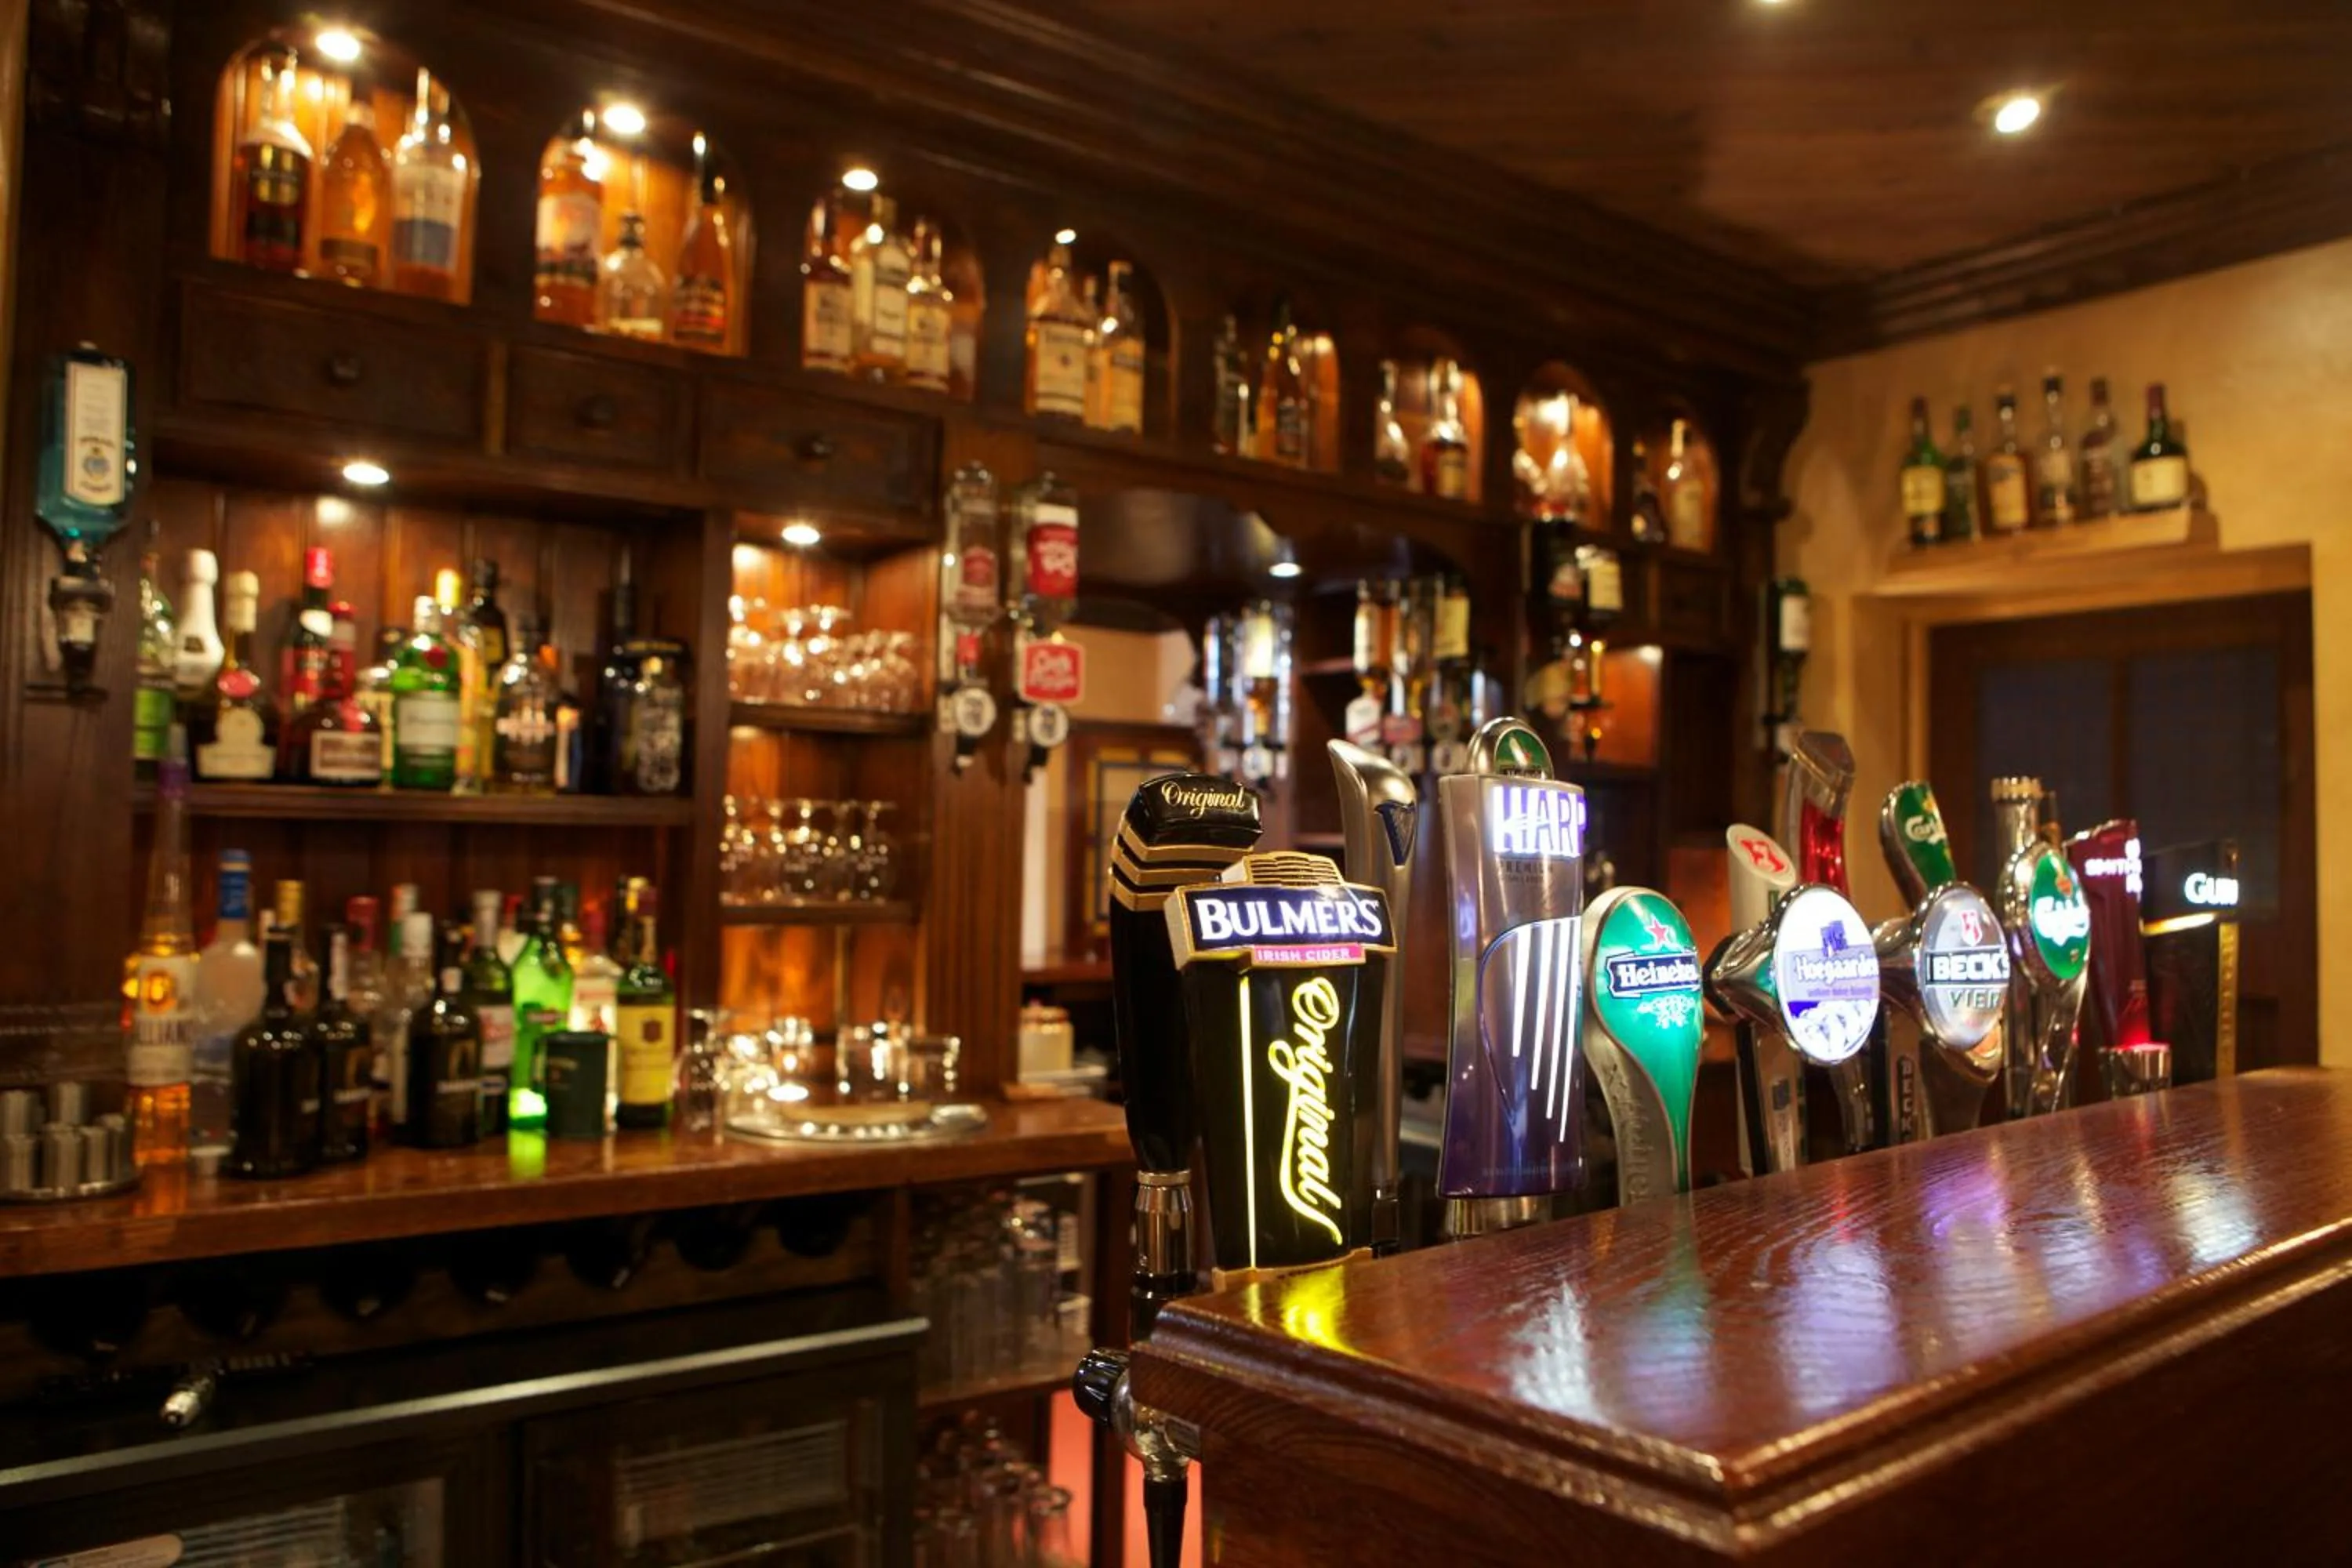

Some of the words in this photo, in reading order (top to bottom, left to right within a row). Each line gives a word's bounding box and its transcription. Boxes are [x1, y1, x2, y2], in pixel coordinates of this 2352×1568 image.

[1161, 780, 1245, 819] Original
[1493, 786, 1587, 858] HARP
[1195, 898, 1382, 940] BULMERS
[1258, 949, 1301, 961] IRISH
[1306, 947, 1351, 960] CIDER
[1268, 977, 1343, 1245] Original
